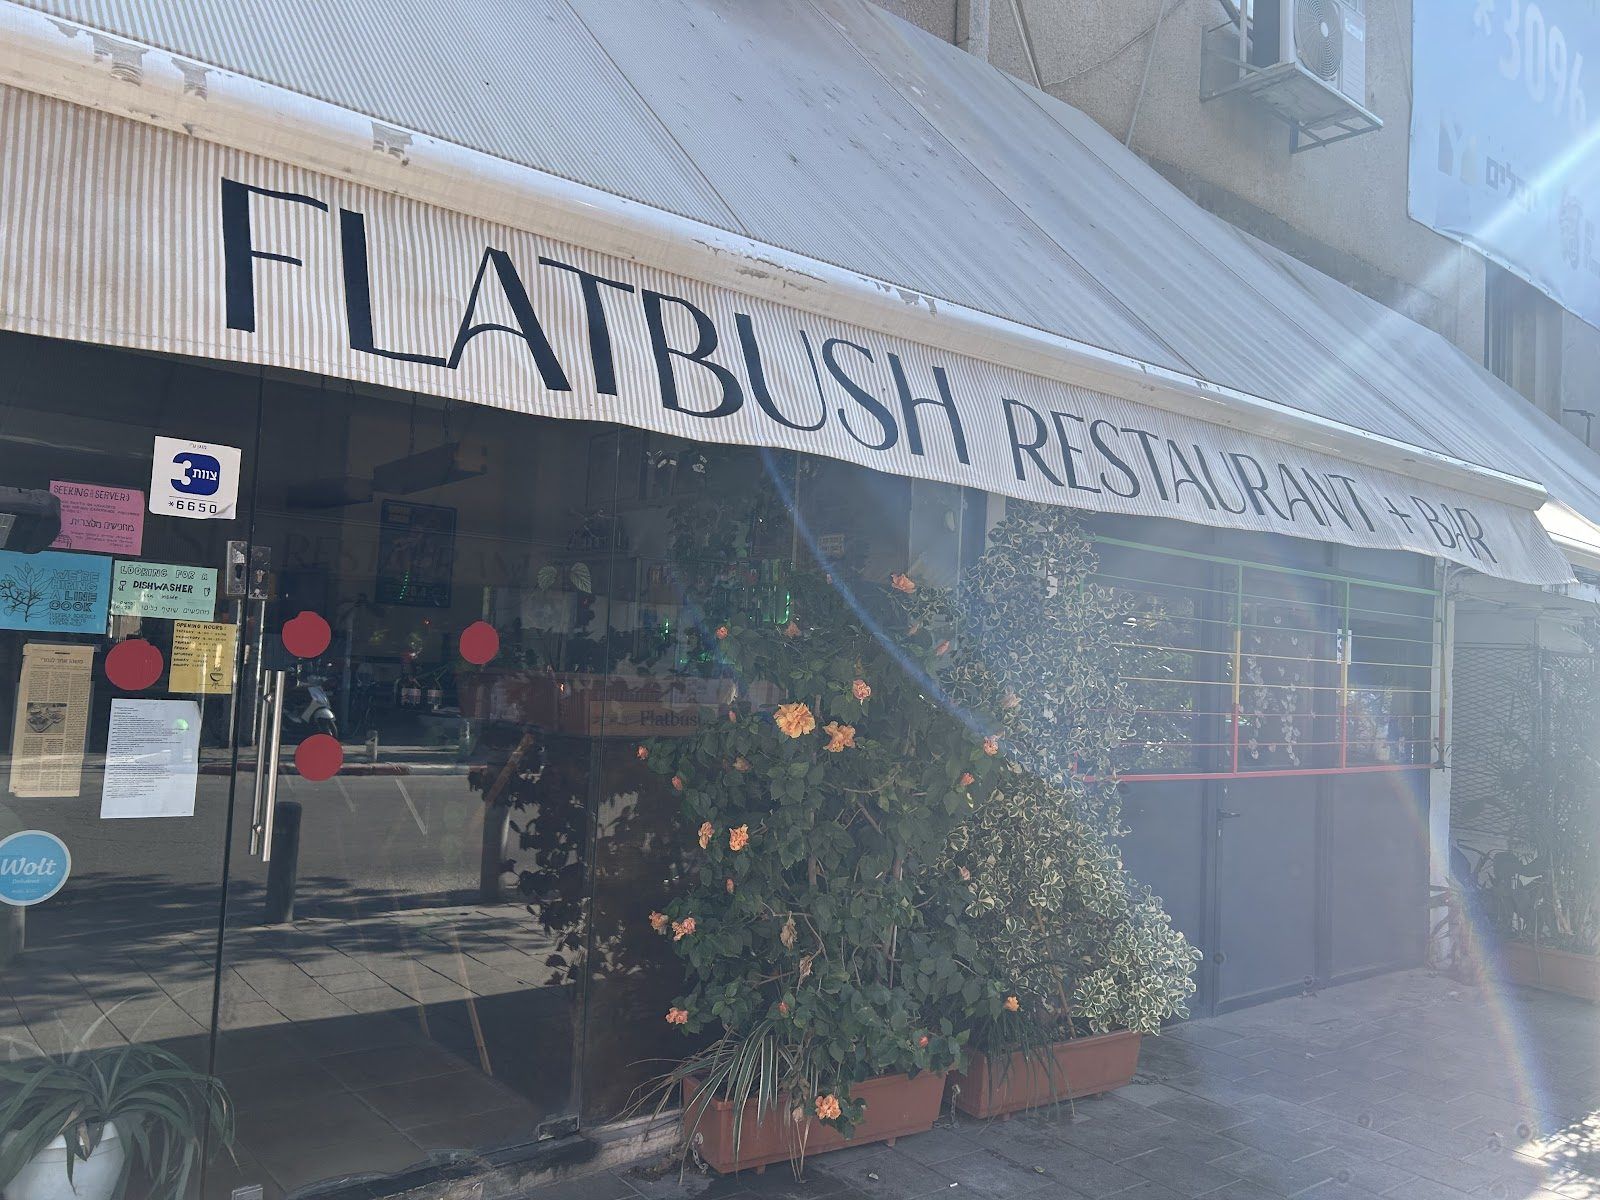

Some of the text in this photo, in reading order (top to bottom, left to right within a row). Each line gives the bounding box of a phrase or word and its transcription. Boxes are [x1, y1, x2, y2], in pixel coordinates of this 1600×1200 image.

[221, 177, 970, 465] FLATBUSH
[1001, 398, 1375, 532] RESTAURANT
[1416, 496, 1498, 563] BAR
[192, 468, 218, 481] צוות
[53, 485, 89, 497] SEEKING
[120, 565, 168, 577] LOOKING
[175, 569, 196, 580] FOR
[133, 580, 194, 593] DISHWASHER
[65, 591, 98, 602] LINE
[639, 709, 699, 727] Flatbus
[0, 857, 57, 876] Wolt
